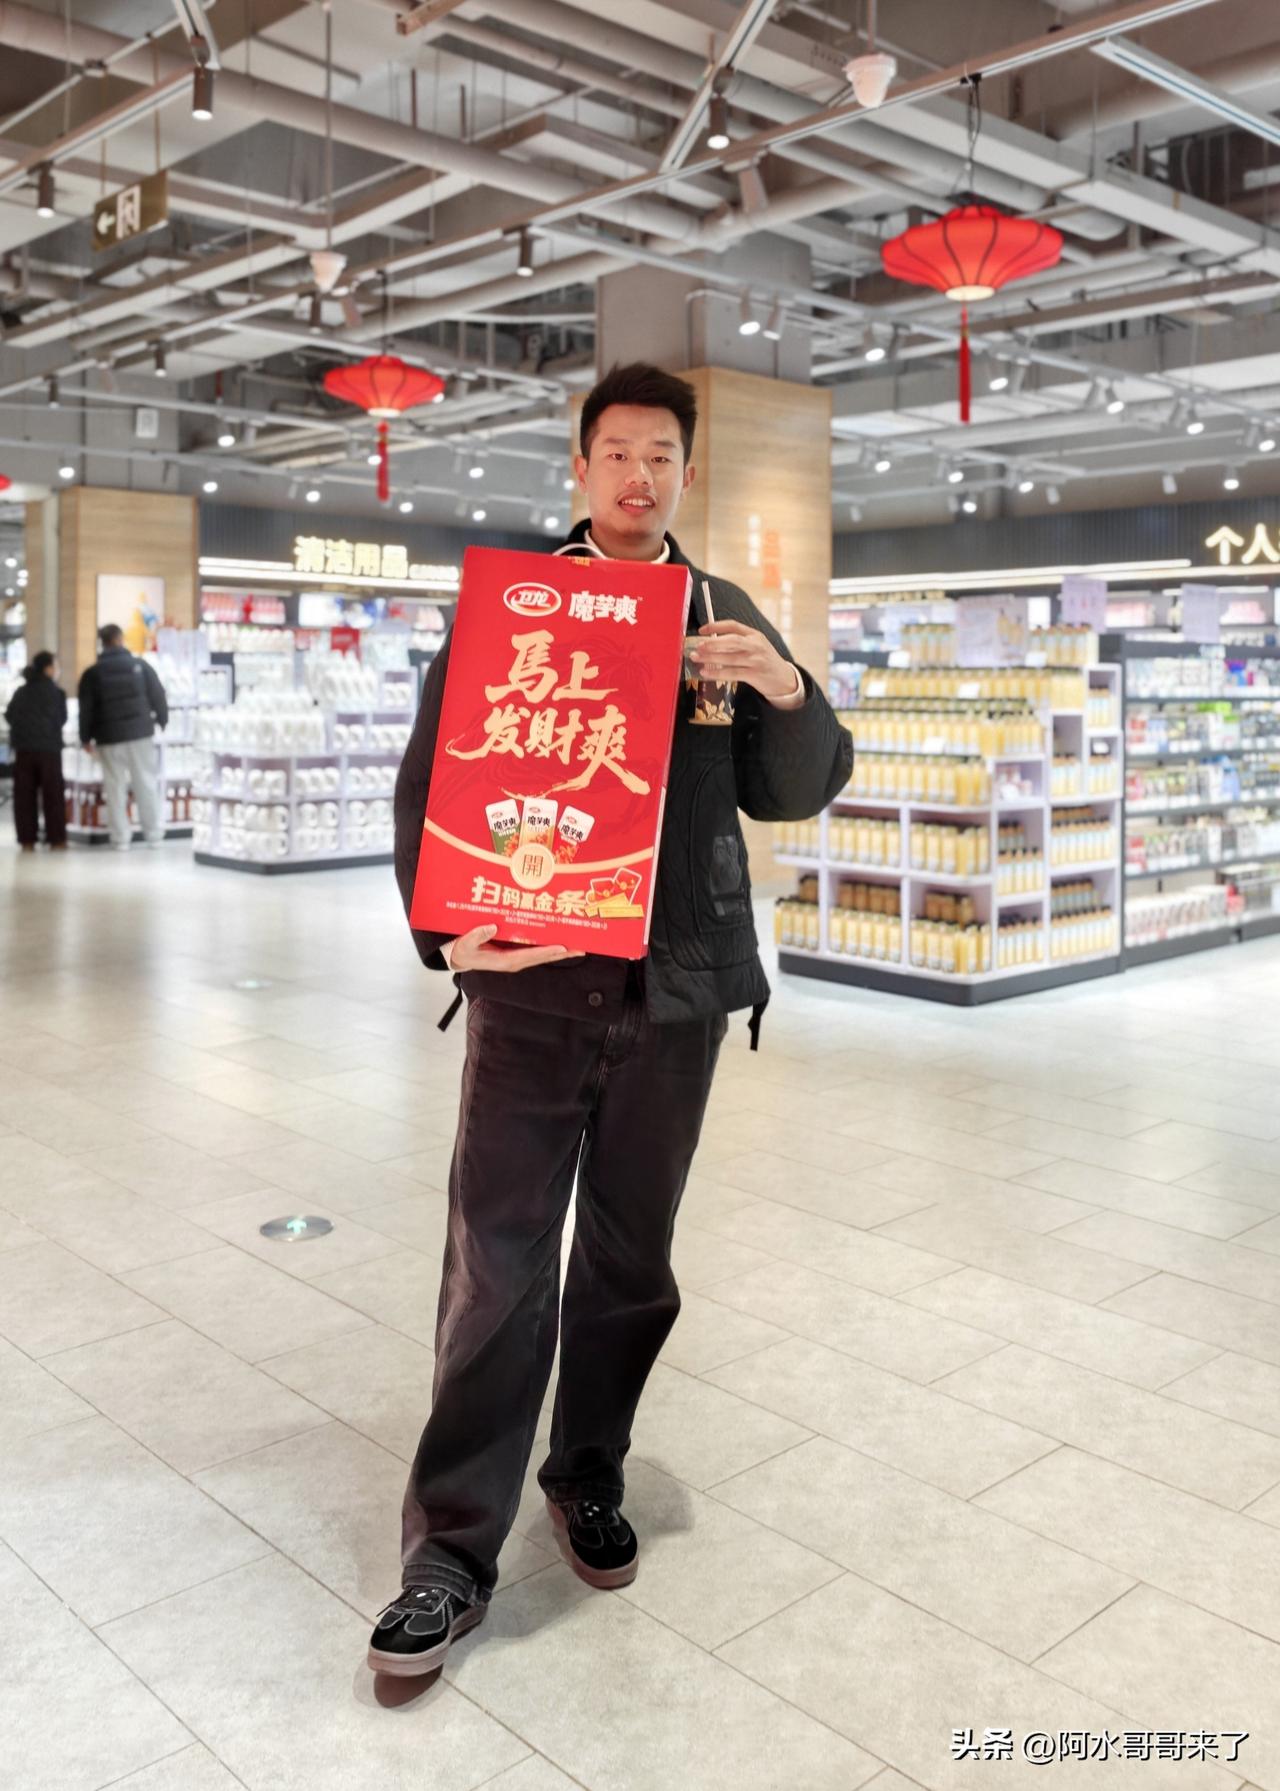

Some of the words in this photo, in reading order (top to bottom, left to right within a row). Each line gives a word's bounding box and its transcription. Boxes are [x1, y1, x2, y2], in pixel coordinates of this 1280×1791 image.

[1205, 523, 1280, 565] 个人
[568, 590, 638, 625] 魔芋爽
[485, 629, 619, 704] 馬上
[445, 703, 651, 800] 发财爽
[521, 854, 544, 877] 開
